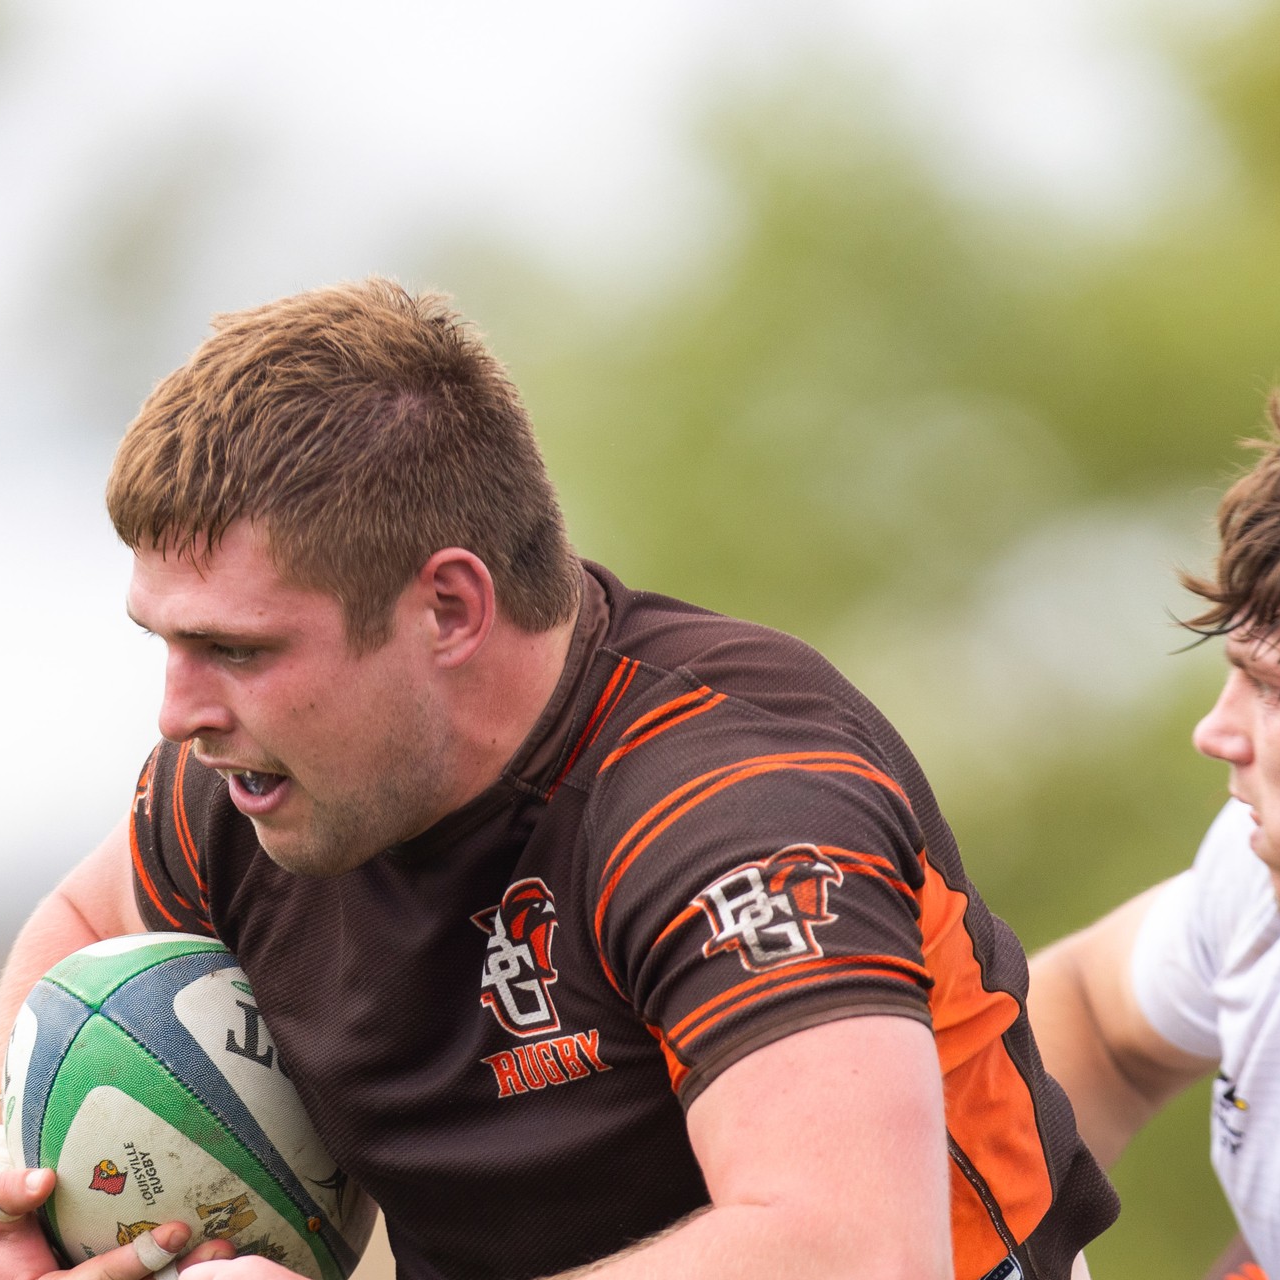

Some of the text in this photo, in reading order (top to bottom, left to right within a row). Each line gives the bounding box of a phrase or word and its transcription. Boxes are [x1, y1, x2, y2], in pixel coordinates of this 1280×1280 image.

[480, 1028, 613, 1099] RUGBY
[123, 1141, 157, 1207] LOUISVILLE
[138, 1151, 165, 1195] RUGBY
